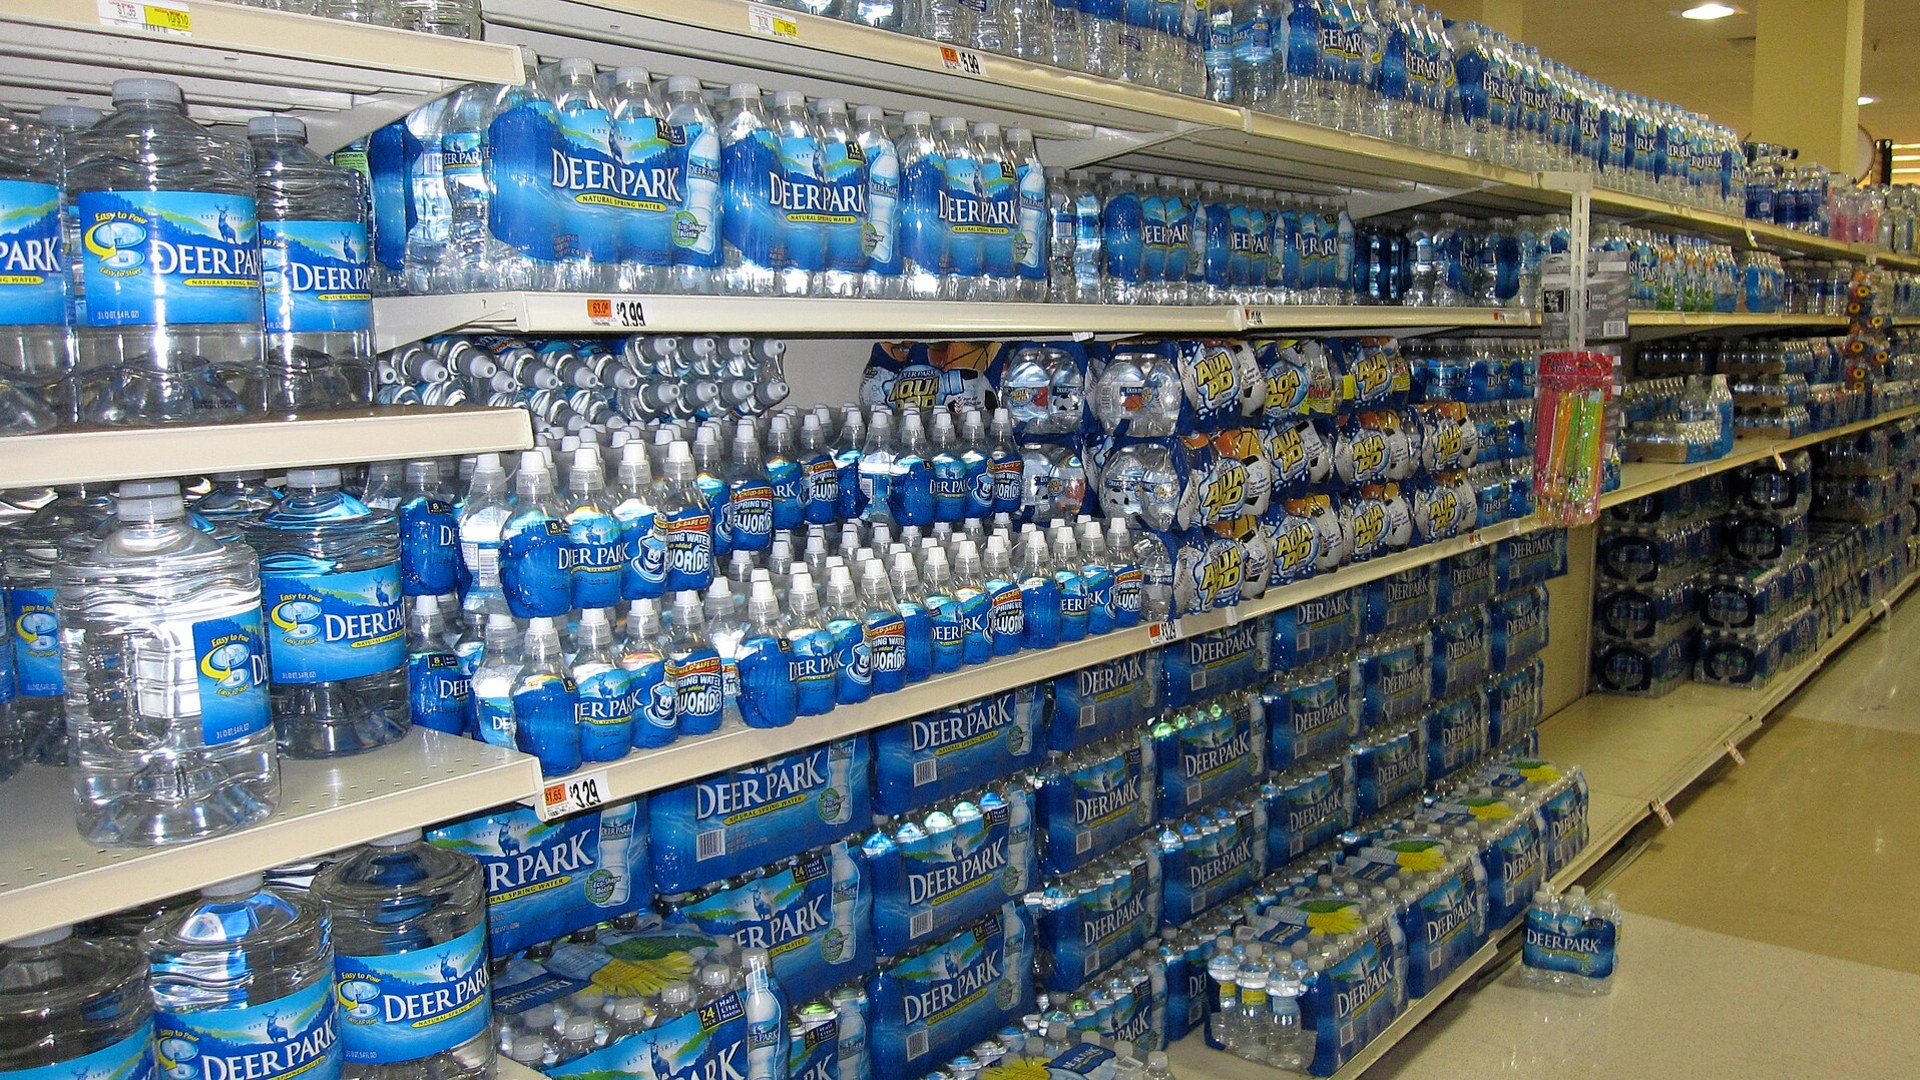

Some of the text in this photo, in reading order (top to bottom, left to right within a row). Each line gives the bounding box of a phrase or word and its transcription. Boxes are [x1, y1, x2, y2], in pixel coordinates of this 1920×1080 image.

[959, 52, 981, 74] $5.99
[551, 148, 682, 202] DEER PARK
[582, 195, 661, 211] NATURAL SPRING WATER
[769, 171, 869, 215] DEER PARK
[94, 210, 149, 225] Easy to Pour
[790, 214, 853, 223] NATURAL SPRING WATER
[938, 189, 1019, 225] DEER PARK
[150, 239, 231, 275] DEER
[12, 276, 38, 284] WATER
[290, 262, 356, 292] DEER
[616, 302, 646, 327] $3.99
[1195, 352, 1232, 386] AUA
[889, 375, 939, 402] AQUA
[1202, 466, 1246, 507] AUA
[432, 502, 440, 511] 8
[734, 500, 760, 510] SPRING
[551, 522, 558, 531] 8
[686, 531, 711, 544] WATER
[597, 542, 631, 564] PARK
[675, 542, 692, 550] added
[1387, 574, 1431, 602] DEER PARK
[1453, 567, 1472, 587] DEER
[280, 591, 298, 602] Easy
[298, 592, 307, 600] to
[324, 609, 385, 643] DEER
[211, 635, 240, 647] Easy to
[355, 637, 381, 648] NATURAL
[1190, 624, 1257, 666] DEER PARK
[433, 655, 441, 666] 8
[567, 679, 574, 689] 8
[700, 674, 721, 686] WATER
[1081, 669, 1115, 697] DEER
[1383, 674, 1404, 696] DEER
[610, 687, 643, 717] PARK
[1294, 694, 1348, 735] DEER PARK
[492, 715, 509, 731] DE
[912, 702, 1013, 751] DEER PARK
[1185, 729, 1250, 779] DEER PARK
[696, 750, 826, 820] DEER PARK
[1379, 765, 1400, 786] DEER
[545, 778, 601, 809] $1.65 $3.29
[1075, 775, 1139, 825] DEER PARK
[728, 796, 803, 823] NATURAL SPRING WATER
[1290, 789, 1343, 833] DEER PARK
[616, 824, 633, 835] PARK
[517, 833, 595, 889] PARK
[793, 866, 805, 878] 24
[909, 838, 1007, 905] DEER PARK
[1190, 837, 1251, 889] DEER PARK
[508, 877, 564, 899] SPRING WATER
[770, 893, 829, 944] PARK
[1084, 889, 1145, 947] DEER PARK
[1527, 929, 1601, 955] DEER PARK
[904, 949, 1001, 1026] DEER PARK
[383, 985, 455, 1023] DEER
[418, 1013, 446, 1027] NATURAL
[448, 1005, 468, 1018] SPRING
[700, 994, 735, 1022] 24 Half
[720, 1002, 739, 1014] Liter
[201, 1016, 339, 1080] DEER PARK
[627, 1038, 680, 1067] EST. 1873
